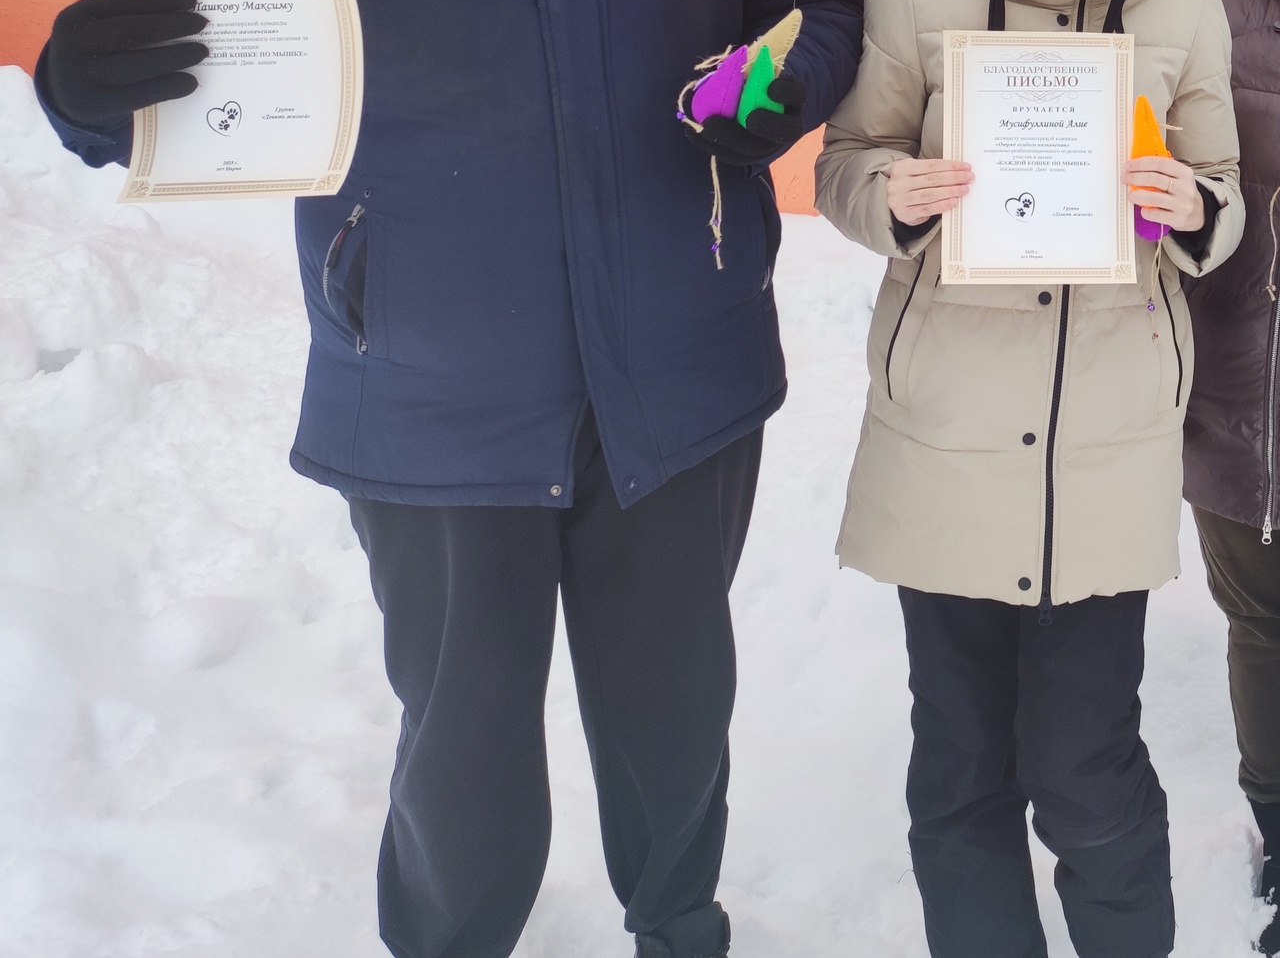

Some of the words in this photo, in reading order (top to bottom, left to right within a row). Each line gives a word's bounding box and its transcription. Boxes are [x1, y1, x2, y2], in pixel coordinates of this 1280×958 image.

[242, 1, 294, 13] Максиму
[983, 65, 1098, 74] БЛАГОДАРСТВЕННОЕ
[1006, 75, 1079, 87] ПИСЬМО
